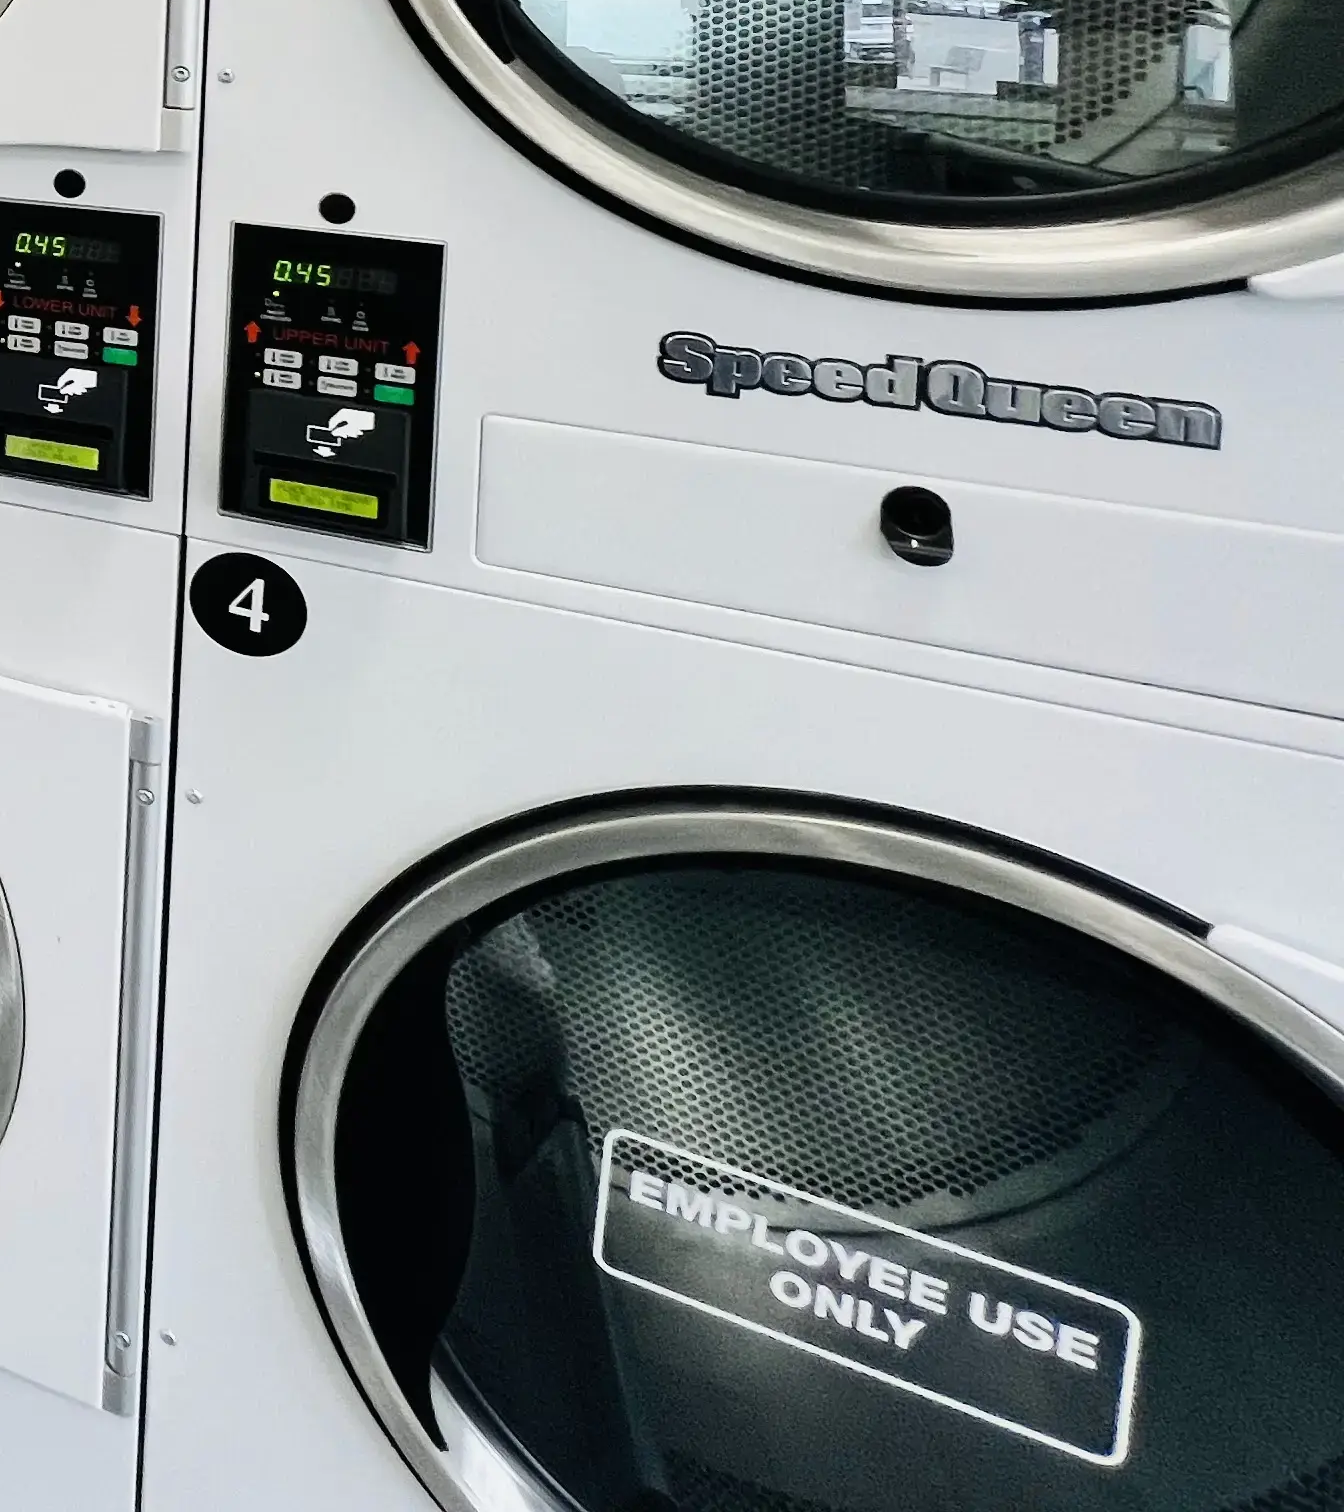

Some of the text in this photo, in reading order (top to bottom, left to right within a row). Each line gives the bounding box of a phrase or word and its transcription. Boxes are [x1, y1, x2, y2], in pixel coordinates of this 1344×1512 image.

[11, 294, 120, 320] LOWER UNIT
[271, 327, 391, 357] UPPER UNIT
[226, 577, 270, 635] 4
[628, 1169, 1100, 1371] EMPLOYEE USE
[768, 1268, 927, 1351] ONLY
